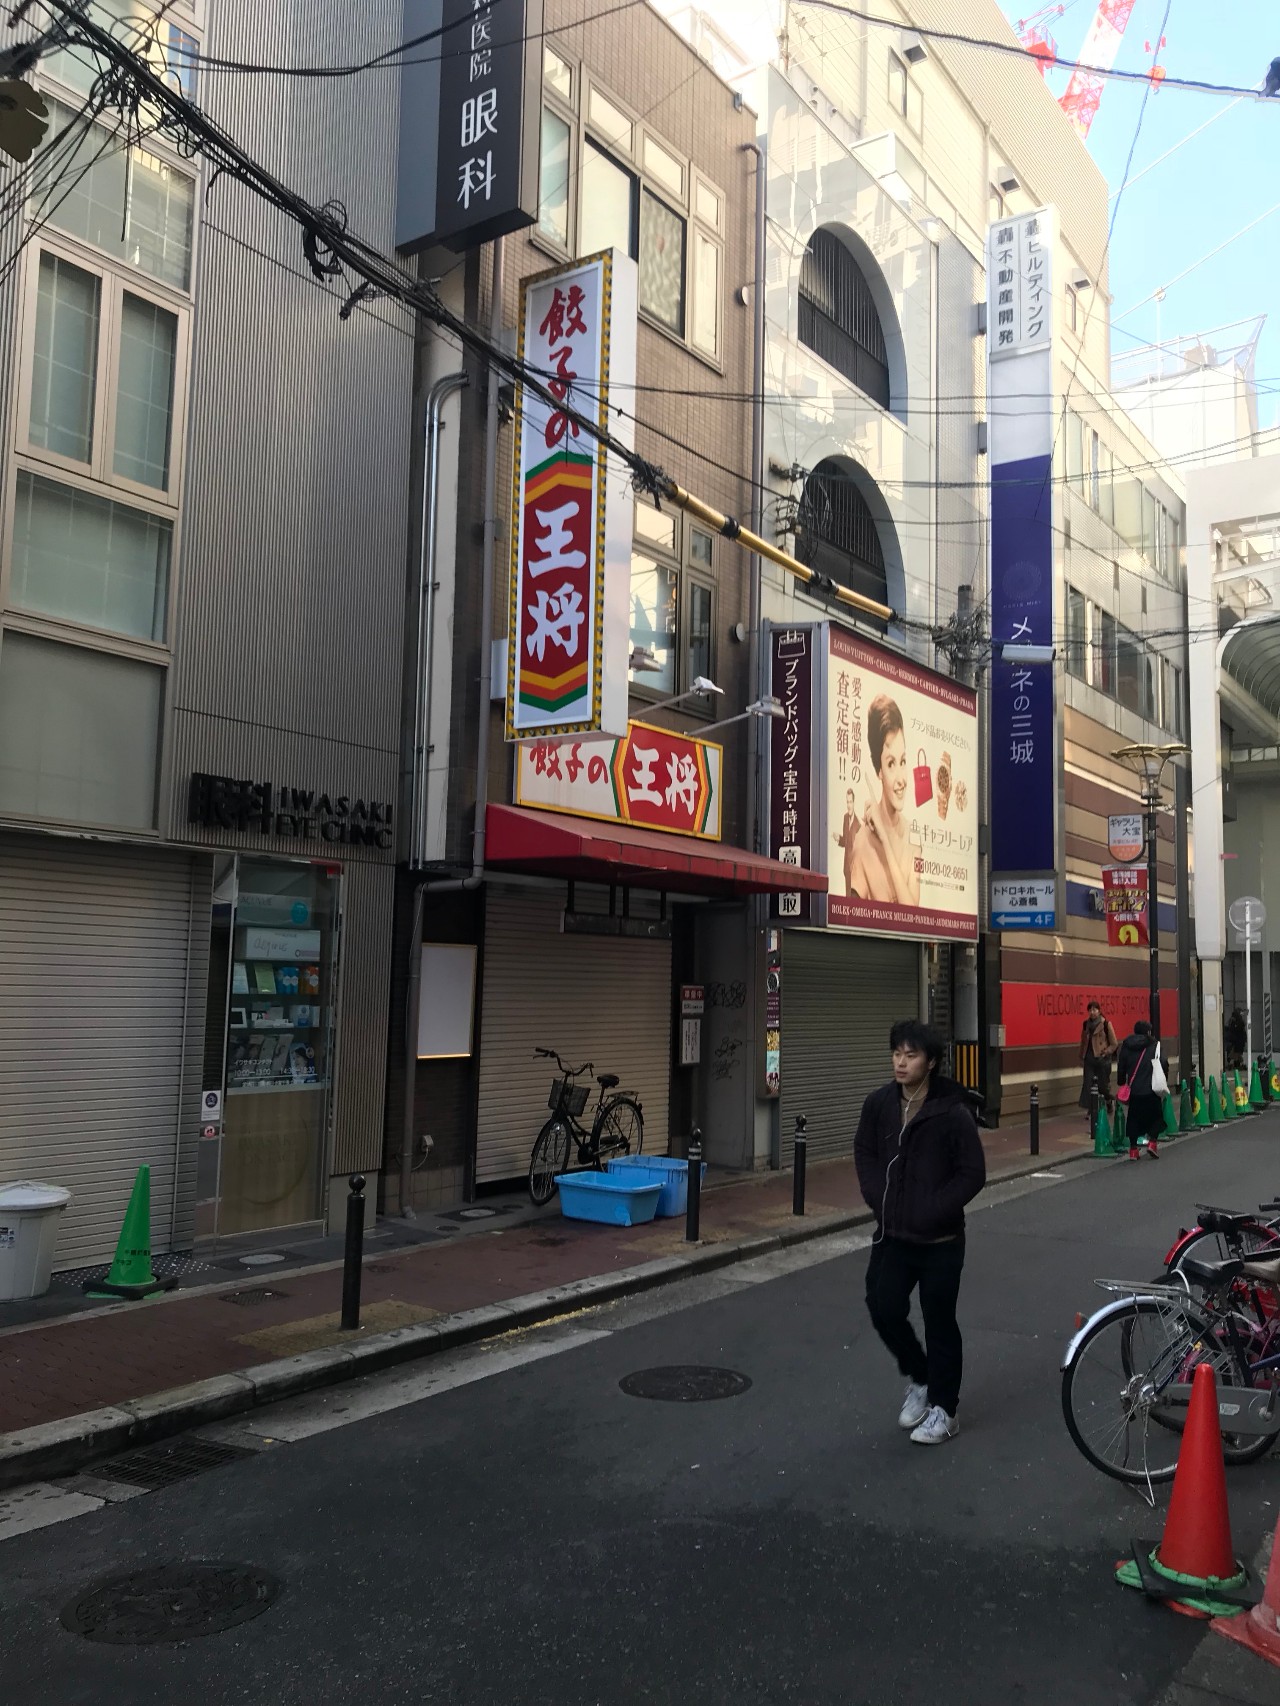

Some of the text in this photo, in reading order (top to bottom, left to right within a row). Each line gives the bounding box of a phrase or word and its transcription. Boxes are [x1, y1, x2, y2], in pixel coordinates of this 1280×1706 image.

[457, 87, 498, 210] 眼科
[525, 284, 589, 663] 餃子の 王将
[1010, 616, 1034, 764] メネの三城
[851, 677, 862, 783] 愛と感動の
[783, 658, 799, 843] ブランドバッグ・宝石・時計
[529, 742, 699, 816] 餃子の 王将
[281, 786, 393, 825] IWASAKI
[276, 813, 393, 850] EYE CLINIC
[993, 885, 1054, 896] トドロキホール
[1008, 896, 1038, 907] 心斎橋
[831, 903, 850, 916] ROLEX
[851, 906, 871, 918] OMEGA
[872, 909, 893, 921] FRANCK
[893, 911, 914, 923] MULLER
[1034, 913, 1053, 925] 4F
[1037, 994, 1084, 1016] WELCOME
